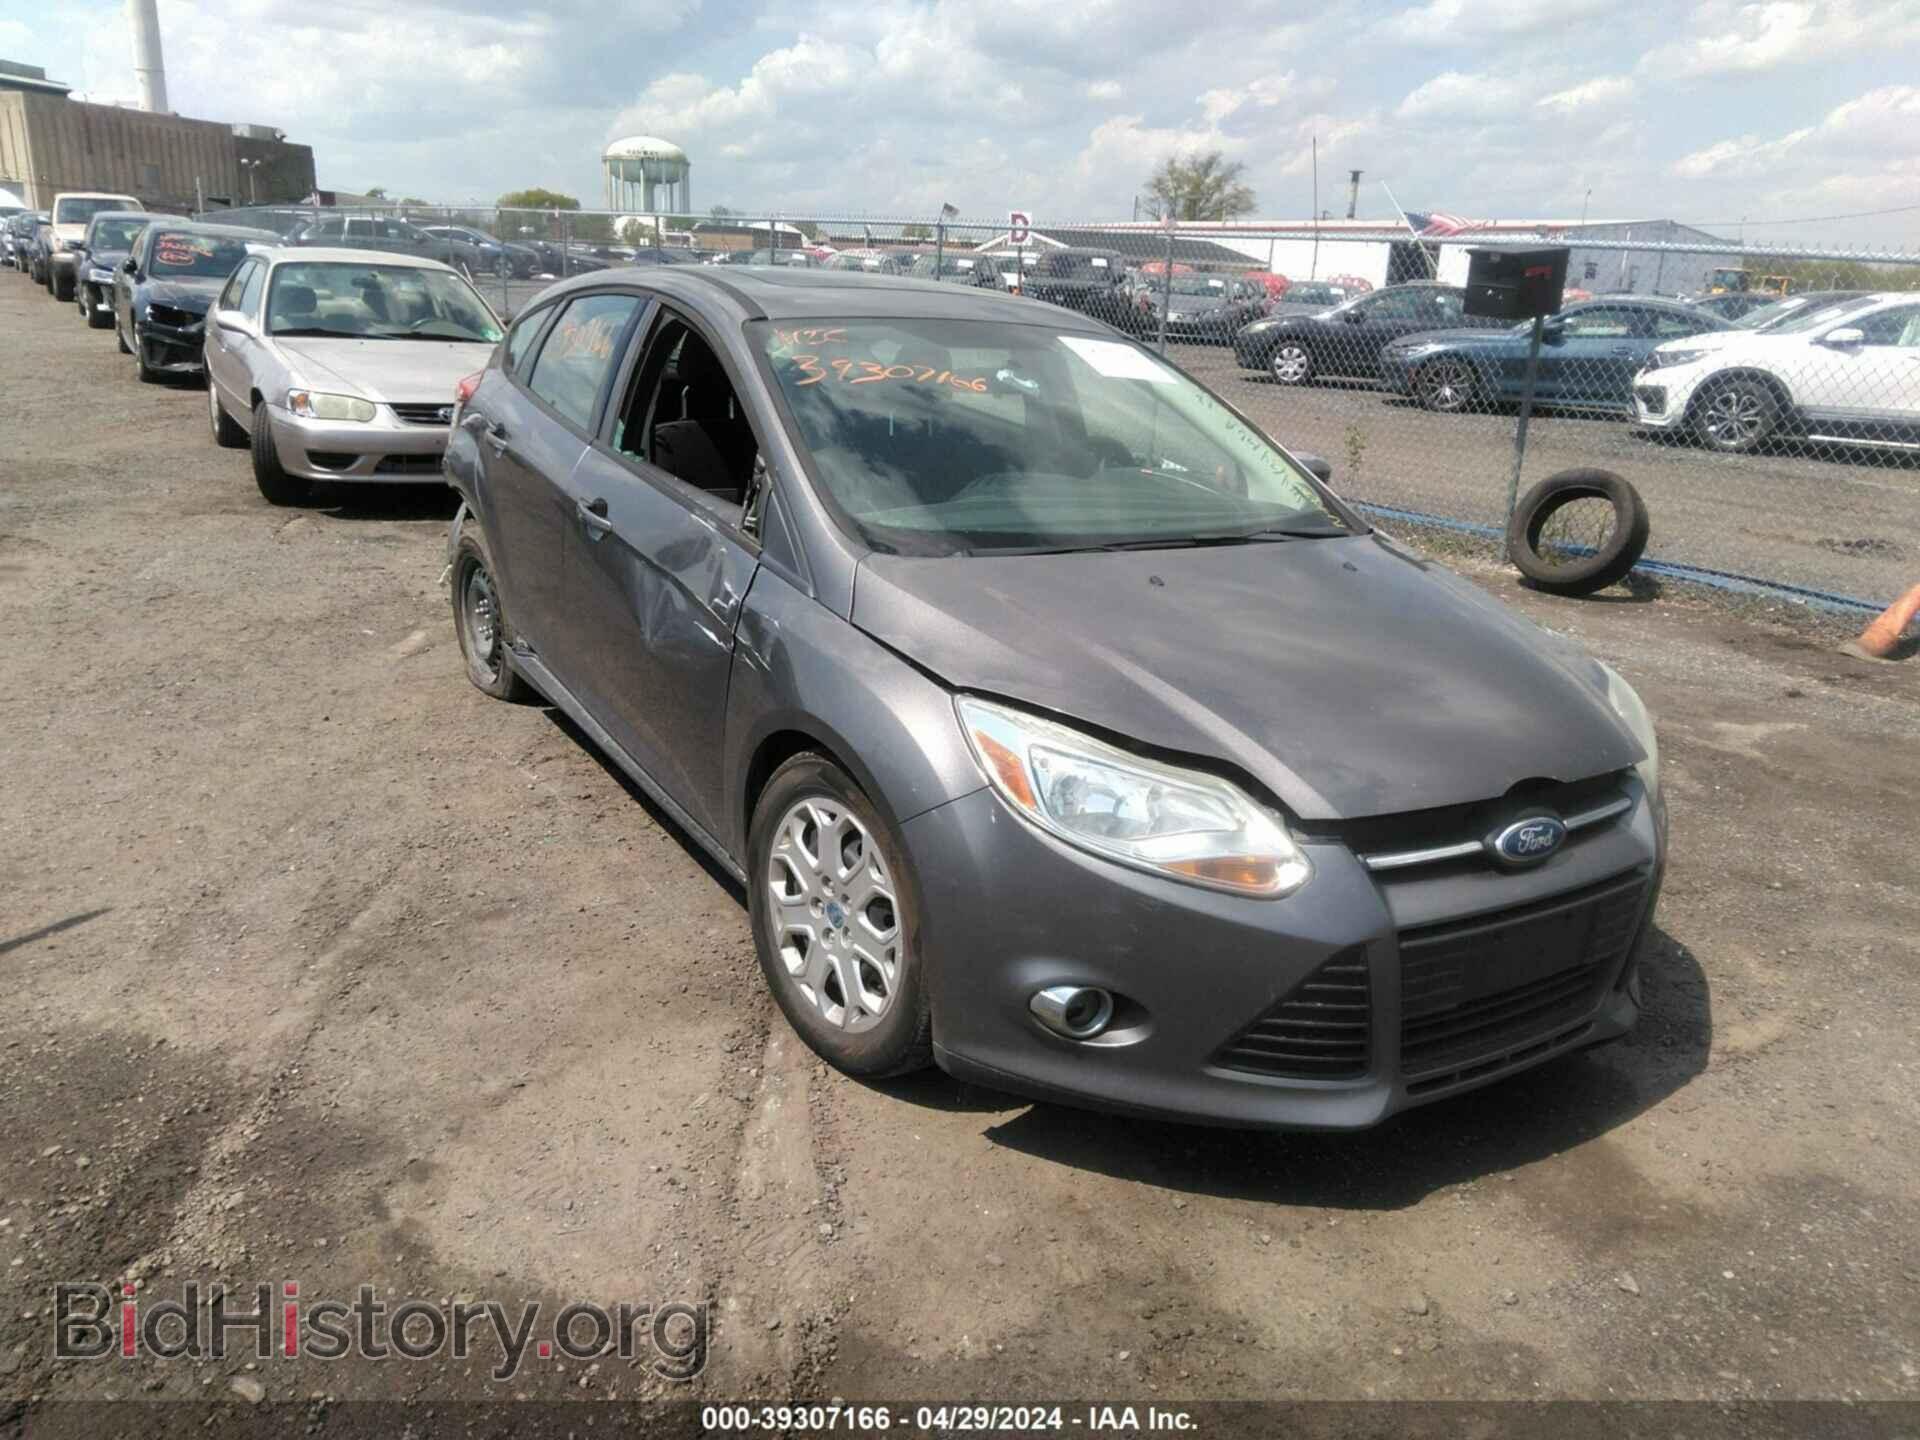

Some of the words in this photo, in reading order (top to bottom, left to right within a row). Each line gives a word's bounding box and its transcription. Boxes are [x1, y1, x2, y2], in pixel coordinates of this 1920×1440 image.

[1011, 213, 1029, 243] D
[791, 354, 988, 392] 39307166
[1517, 825, 1553, 854] Ford
